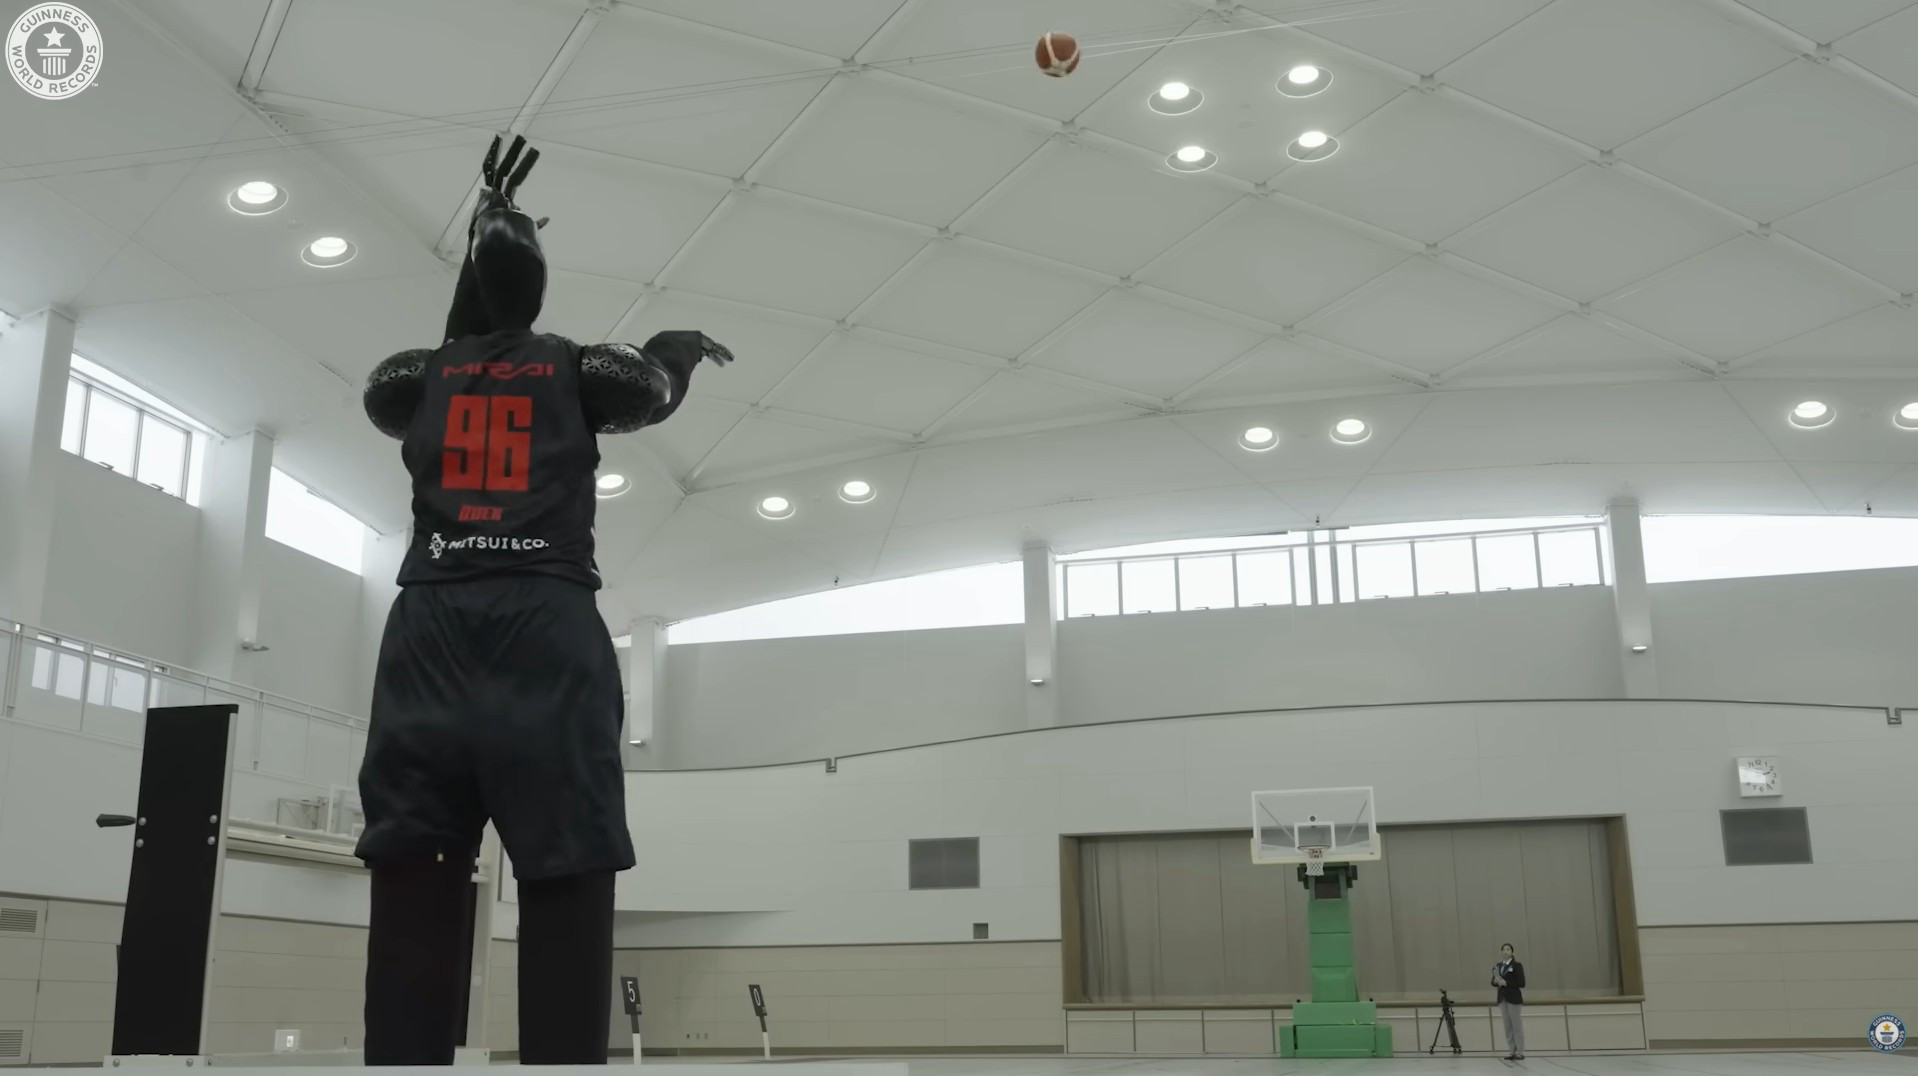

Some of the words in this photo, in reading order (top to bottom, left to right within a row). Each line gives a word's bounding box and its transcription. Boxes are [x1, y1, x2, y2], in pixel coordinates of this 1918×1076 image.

[441, 395, 532, 491] 96
[627, 981, 635, 1002] 5
[753, 988, 761, 1006] 0
